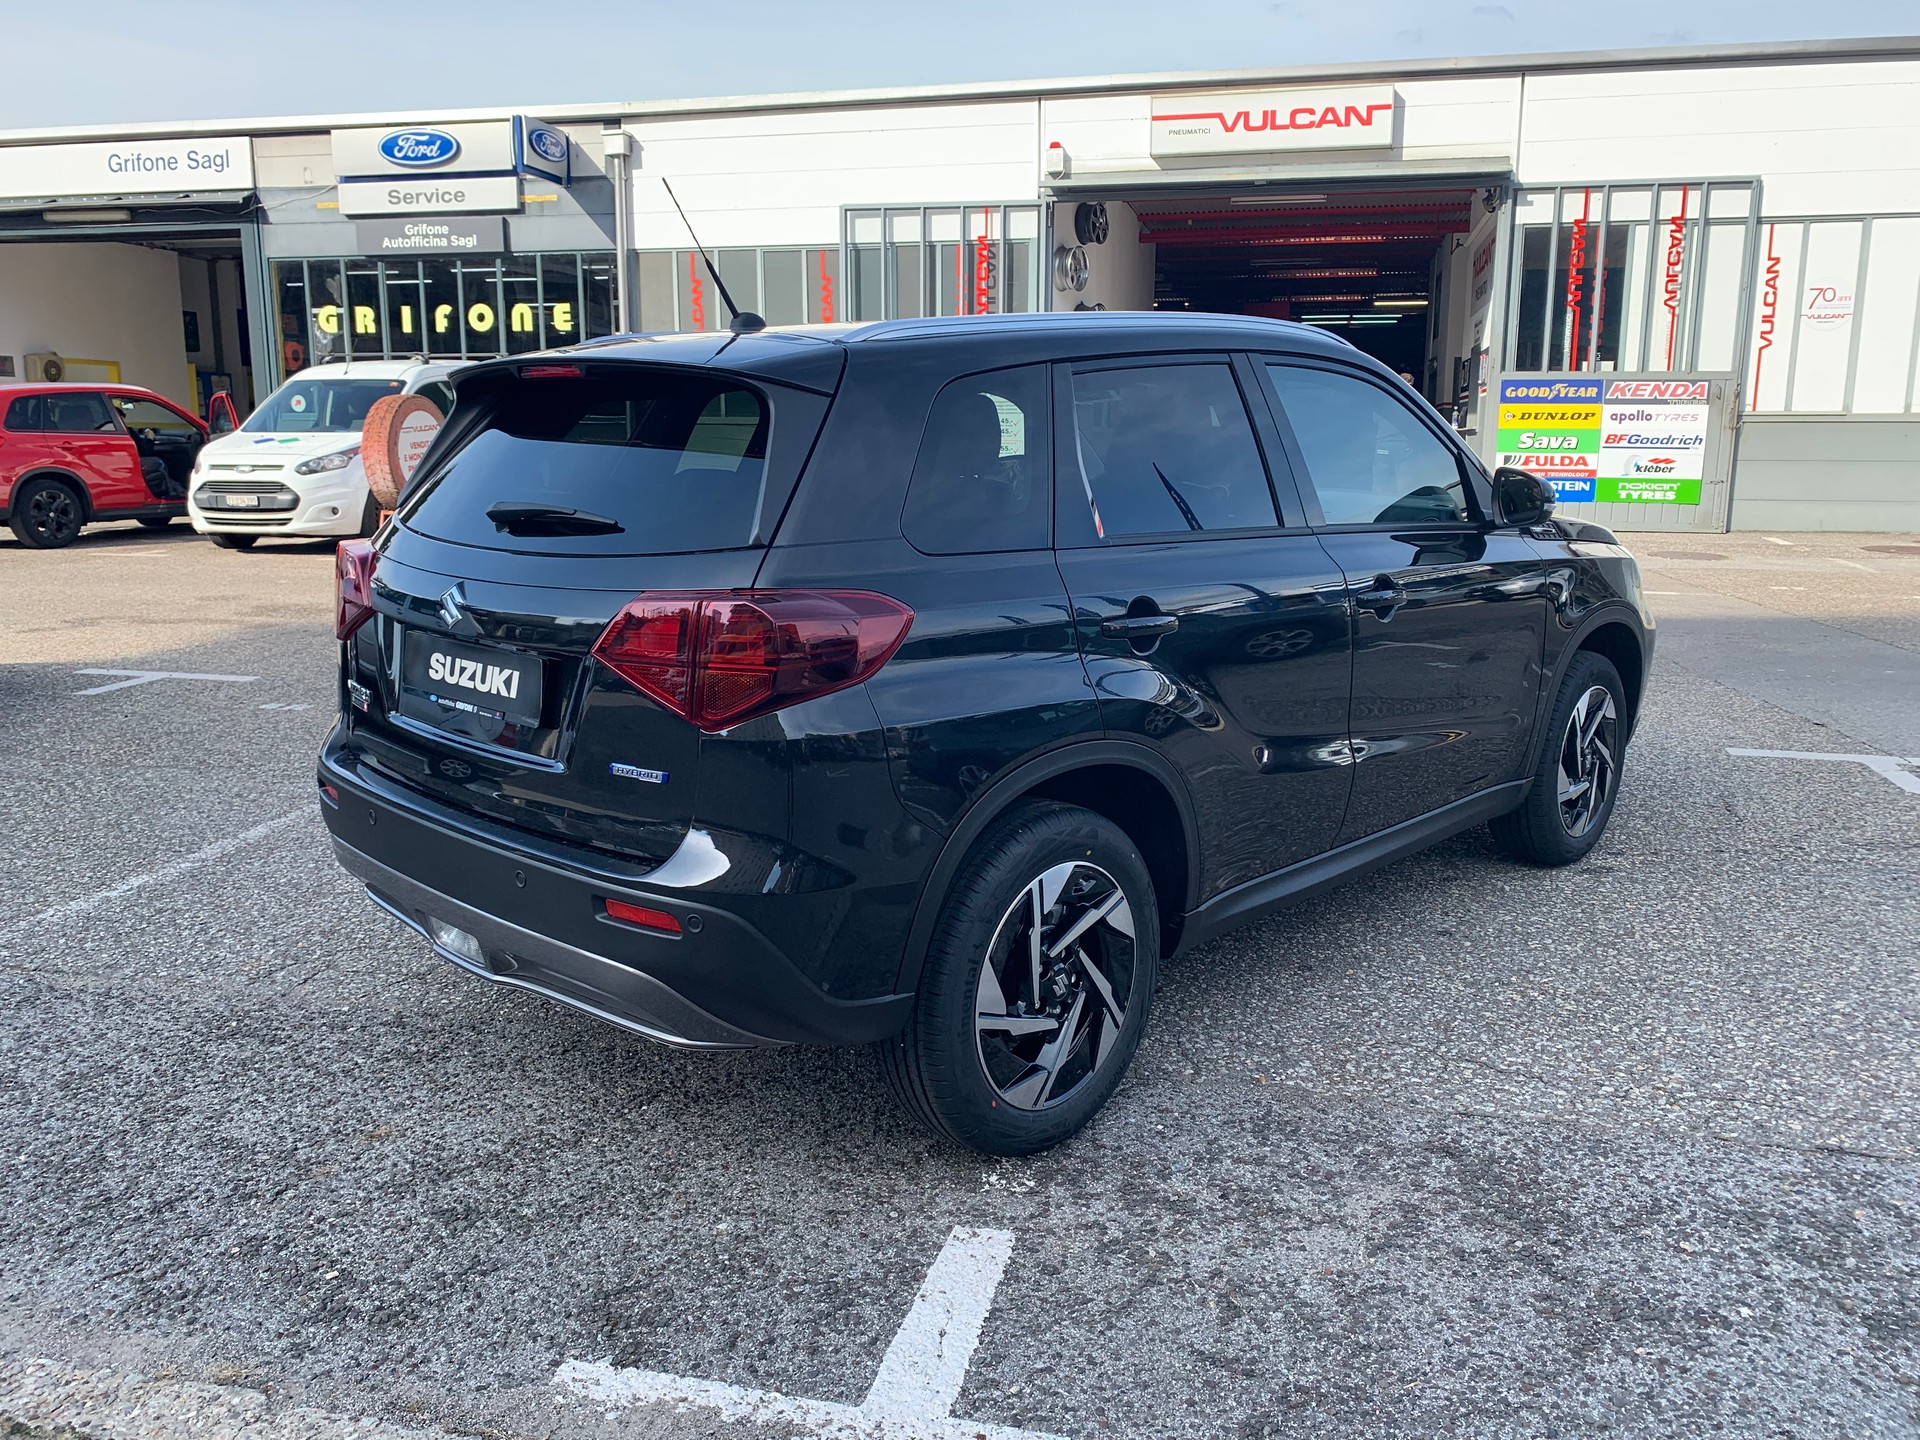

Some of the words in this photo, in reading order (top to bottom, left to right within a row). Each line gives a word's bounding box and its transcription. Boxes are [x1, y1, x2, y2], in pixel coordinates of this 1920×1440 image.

[1205, 104, 1392, 132] VULCAN
[1168, 128, 1211, 136] PNEUMATICI
[394, 133, 441, 158] Ford
[539, 132, 562, 158] Ford
[108, 153, 178, 173] Grifone
[187, 149, 229, 173] Sagl
[387, 188, 466, 206] Service
[404, 223, 449, 236] Grifone
[382, 235, 448, 249] Autofficina
[450, 234, 477, 247] Sagl
[1809, 287, 1837, 310] 70
[318, 302, 573, 334] GRIFONE
[1606, 382, 1709, 399] KENDA
[1518, 412, 1597, 421] DUNLOP
[1610, 410, 1653, 425] apollo
[1654, 413, 1700, 422] TYRES
[1517, 431, 1579, 450] Sava
[1604, 433, 1704, 446] BFGoodrich
[1521, 455, 1589, 467] FULDA
[1618, 482, 1677, 491] nokian
[1617, 490, 1677, 500] TYRES
[428, 652, 520, 699] SUZUKI
[616, 766, 659, 780] HYBRID
